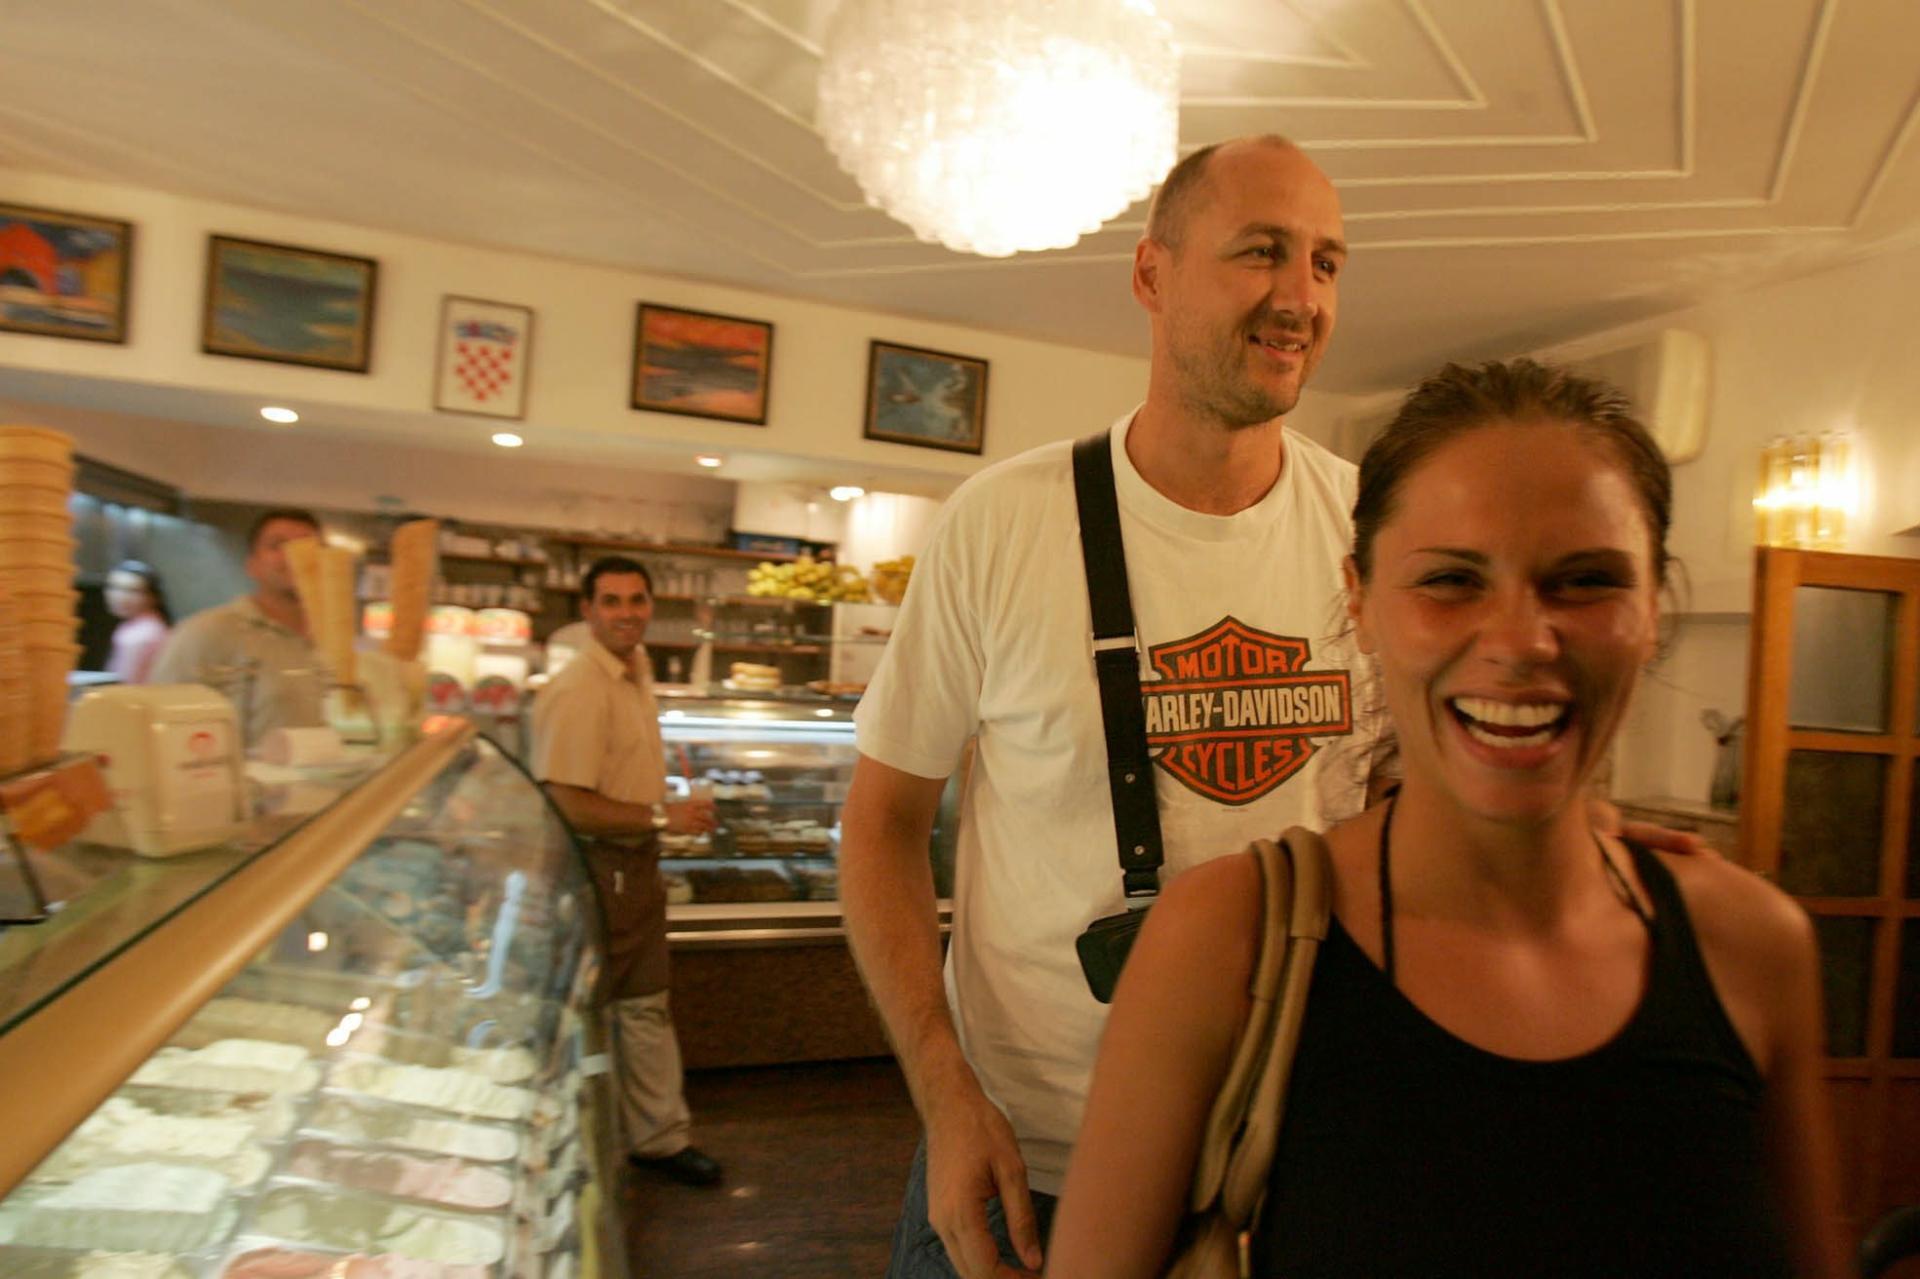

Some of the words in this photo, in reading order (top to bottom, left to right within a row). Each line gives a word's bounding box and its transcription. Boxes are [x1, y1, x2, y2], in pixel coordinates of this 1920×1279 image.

[1176, 633, 1289, 679] MOTOR
[1142, 685, 1341, 733] ARLEY-DAVIDSON
[1182, 739, 1293, 791] CYCLES
